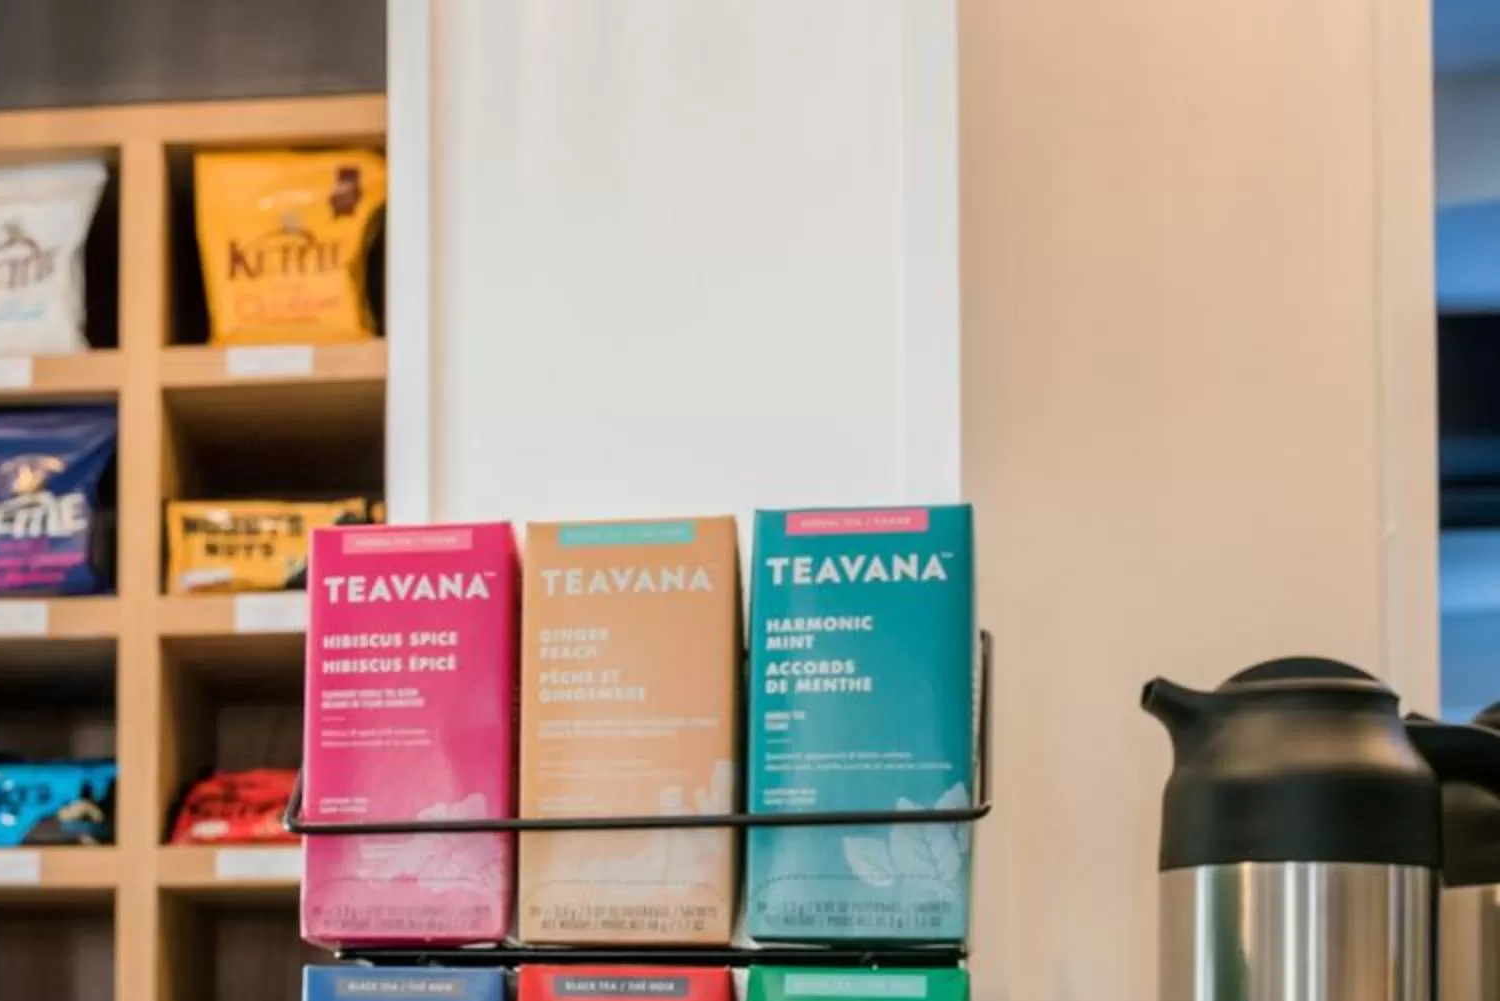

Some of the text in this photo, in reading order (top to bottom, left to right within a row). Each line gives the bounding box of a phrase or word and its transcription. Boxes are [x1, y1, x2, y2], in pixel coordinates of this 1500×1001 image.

[765, 553, 948, 586] TEAVANA
[323, 572, 490, 604] TEAVANA
[765, 615, 873, 633] HARMONIC
[323, 631, 459, 649] HIBISCUS SPICE
[765, 635, 815, 651] MINT
[323, 657, 403, 674] HIBISCUS
[765, 658, 855, 676] ACCORDS
[764, 676, 873, 694] DE MENTHE
